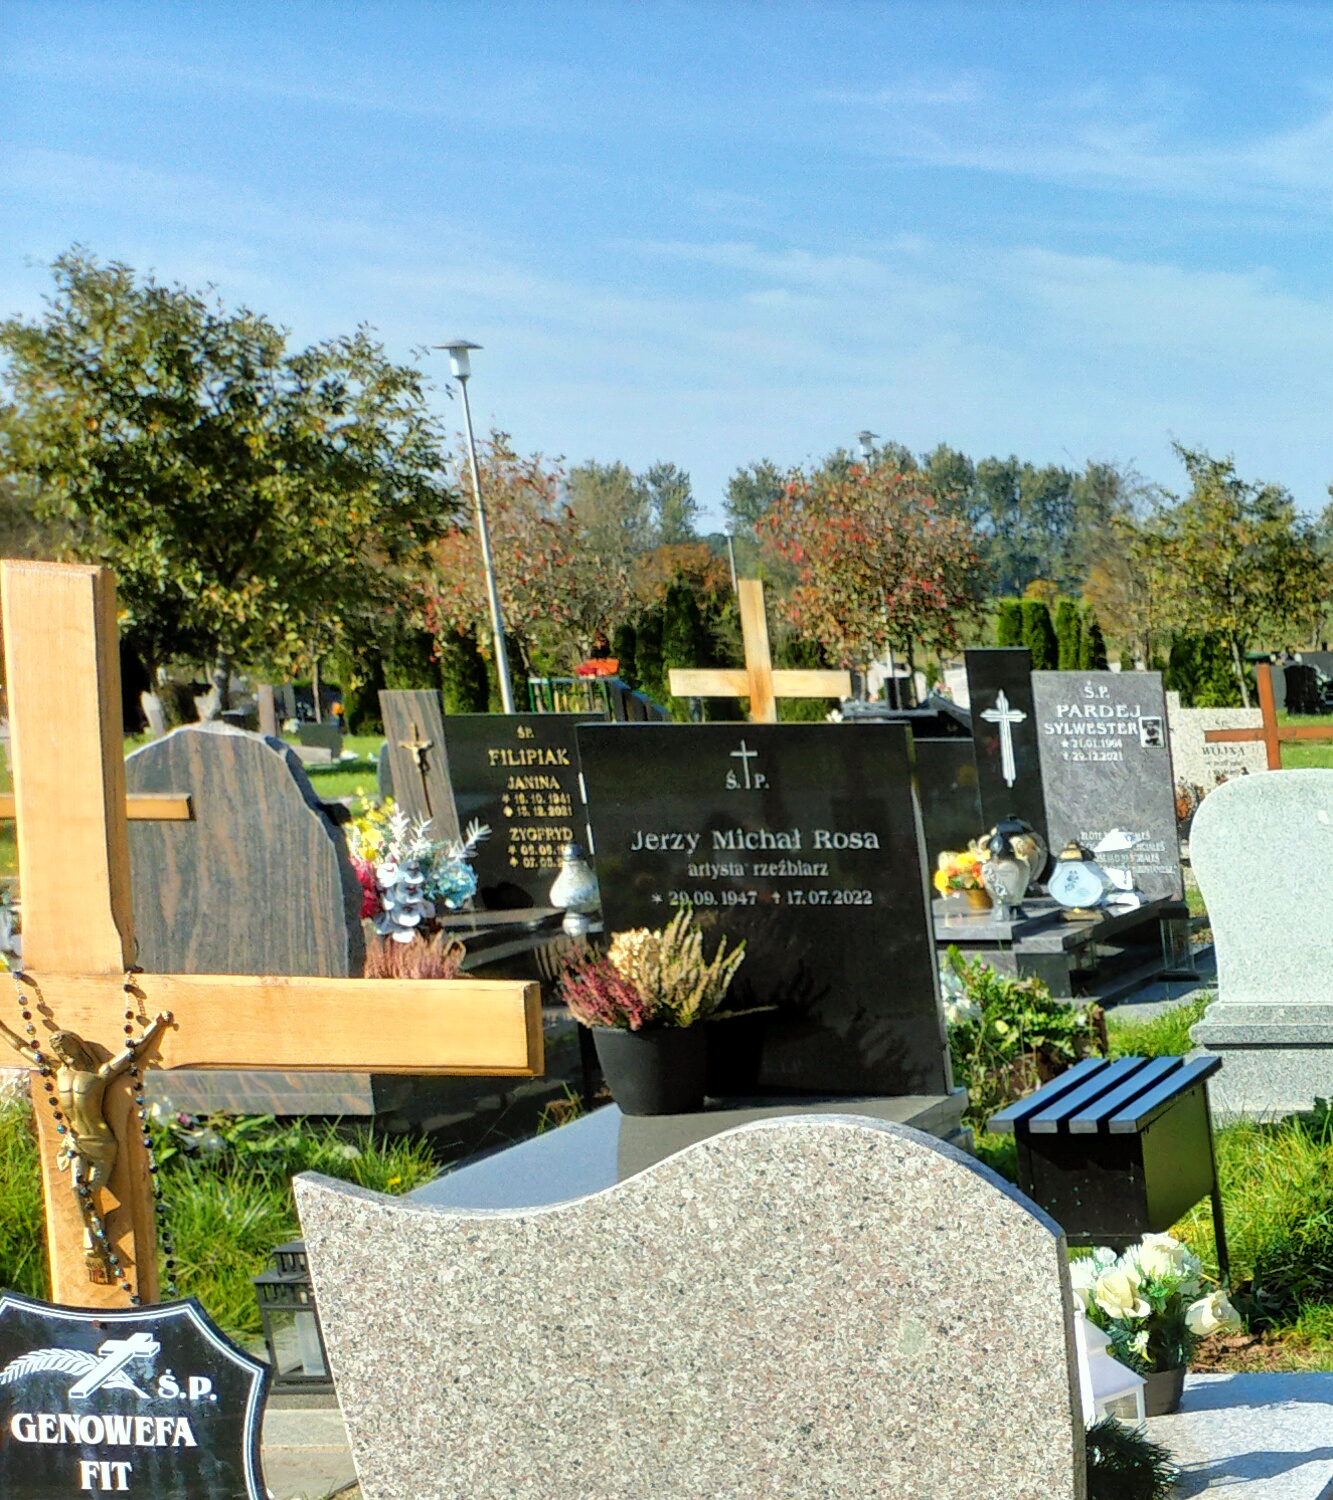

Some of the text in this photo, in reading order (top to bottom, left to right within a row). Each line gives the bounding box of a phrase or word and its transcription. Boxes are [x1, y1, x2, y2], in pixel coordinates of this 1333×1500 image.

[1056, 704, 1141, 718] PARDEJ
[1044, 721, 1139, 735] SYLWESTER
[487, 748, 570, 766] FILIPIAK
[506, 775, 561, 790] JANINA
[631, 828, 880, 856] Jerzy Michał Rosa
[688, 859, 829, 880] artysta rzeźbiarz
[10, 1413, 198, 1448] GENOWEFA
[79, 1460, 133, 1491] FIT
